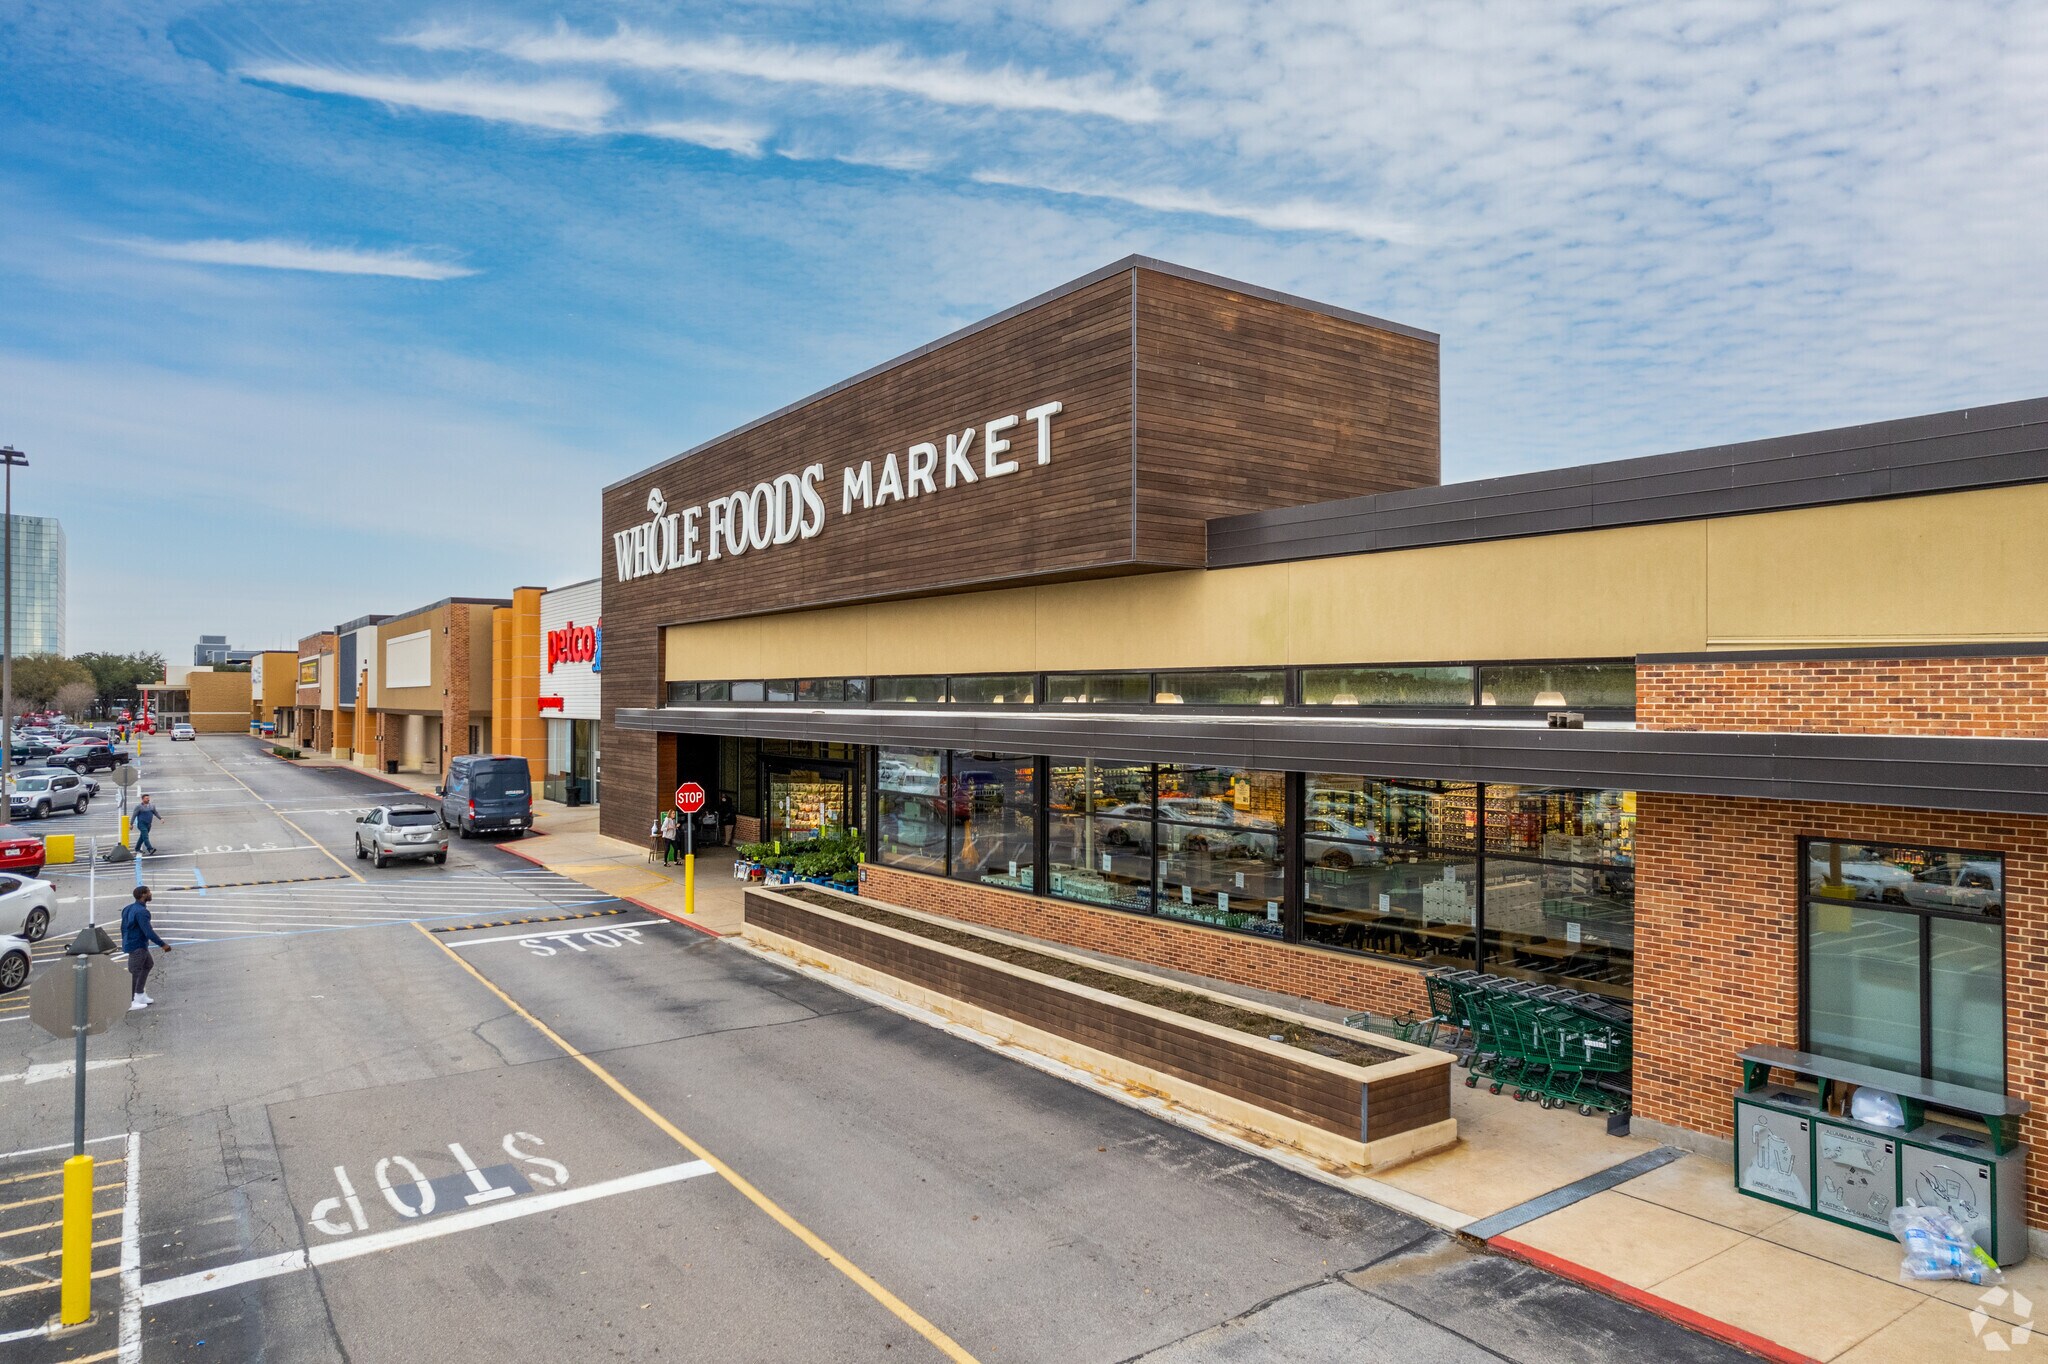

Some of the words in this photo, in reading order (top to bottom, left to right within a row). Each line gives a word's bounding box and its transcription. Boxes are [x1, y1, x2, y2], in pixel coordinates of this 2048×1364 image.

[614, 487, 702, 582] WHOLE
[708, 463, 825, 561] FOODS
[842, 401, 1063, 515] MARKET
[548, 621, 596, 674] petco
[678, 792, 703, 804] STOP
[193, 842, 278, 855] STOP
[519, 928, 643, 956] STOP
[308, 1131, 570, 1236] STOP
